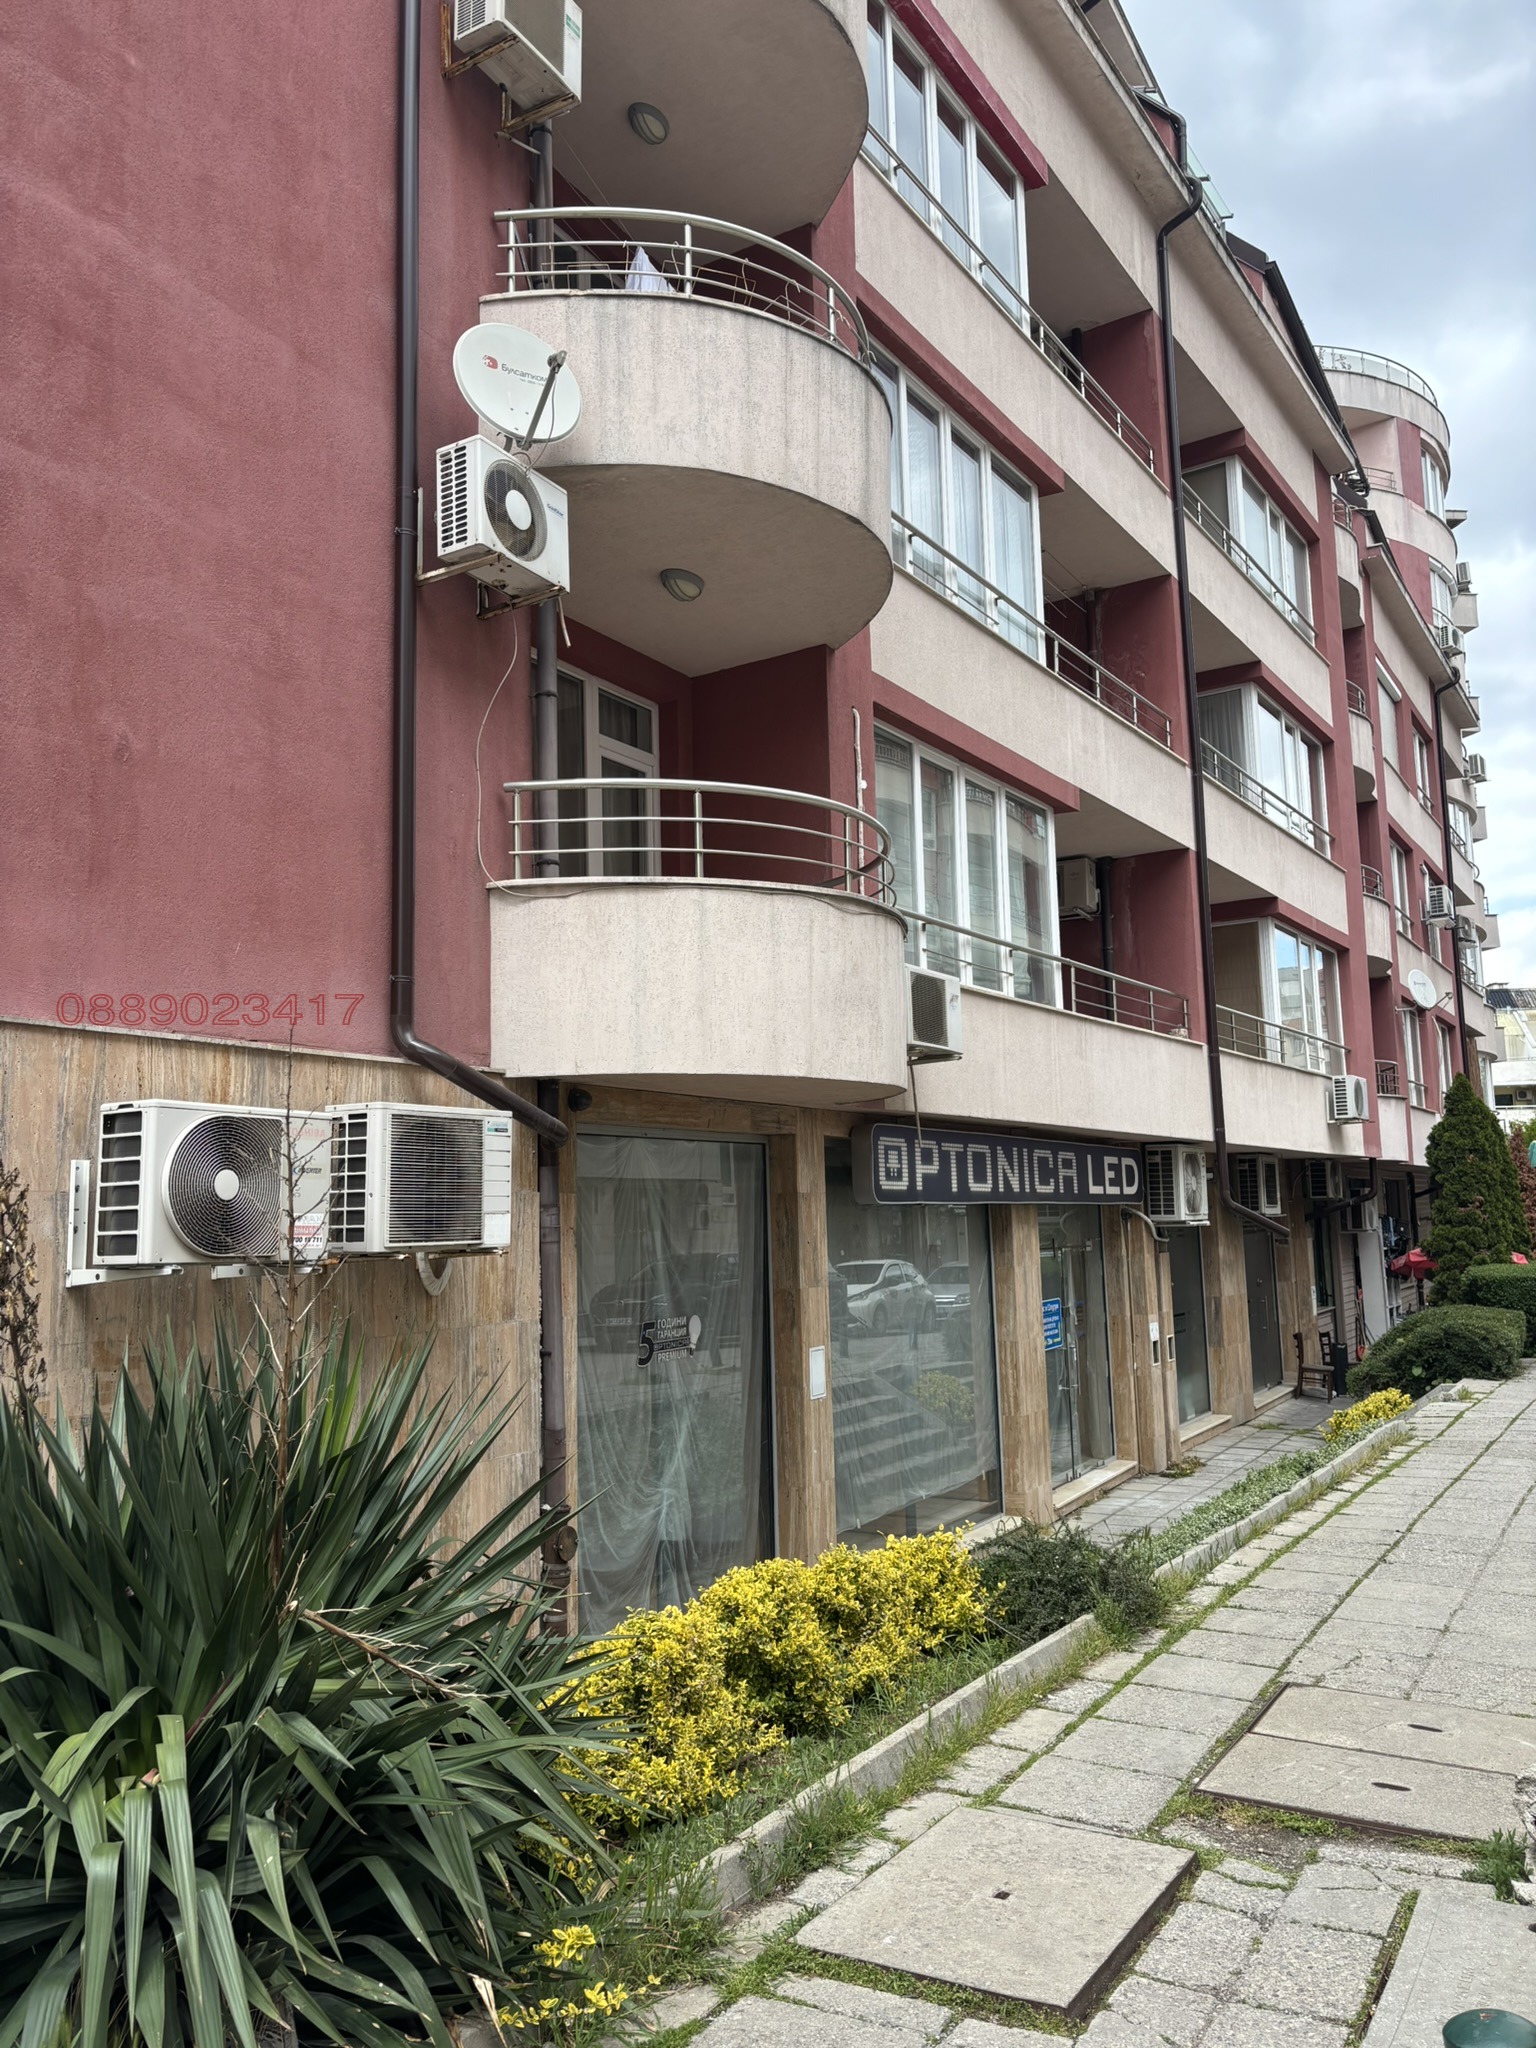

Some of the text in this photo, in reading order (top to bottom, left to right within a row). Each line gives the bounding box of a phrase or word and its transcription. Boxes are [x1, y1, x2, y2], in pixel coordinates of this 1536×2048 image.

[289, 1127, 325, 1138] OSHIBA
[878, 1136, 1139, 1195] OPTONICA LED
[657, 1316, 687, 1329] ГОДИНИ
[657, 1327, 687, 1339] ГАРАНЦИЯ
[637, 1320, 656, 1367] 5
[657, 1349, 687, 1363] PREMIUM
